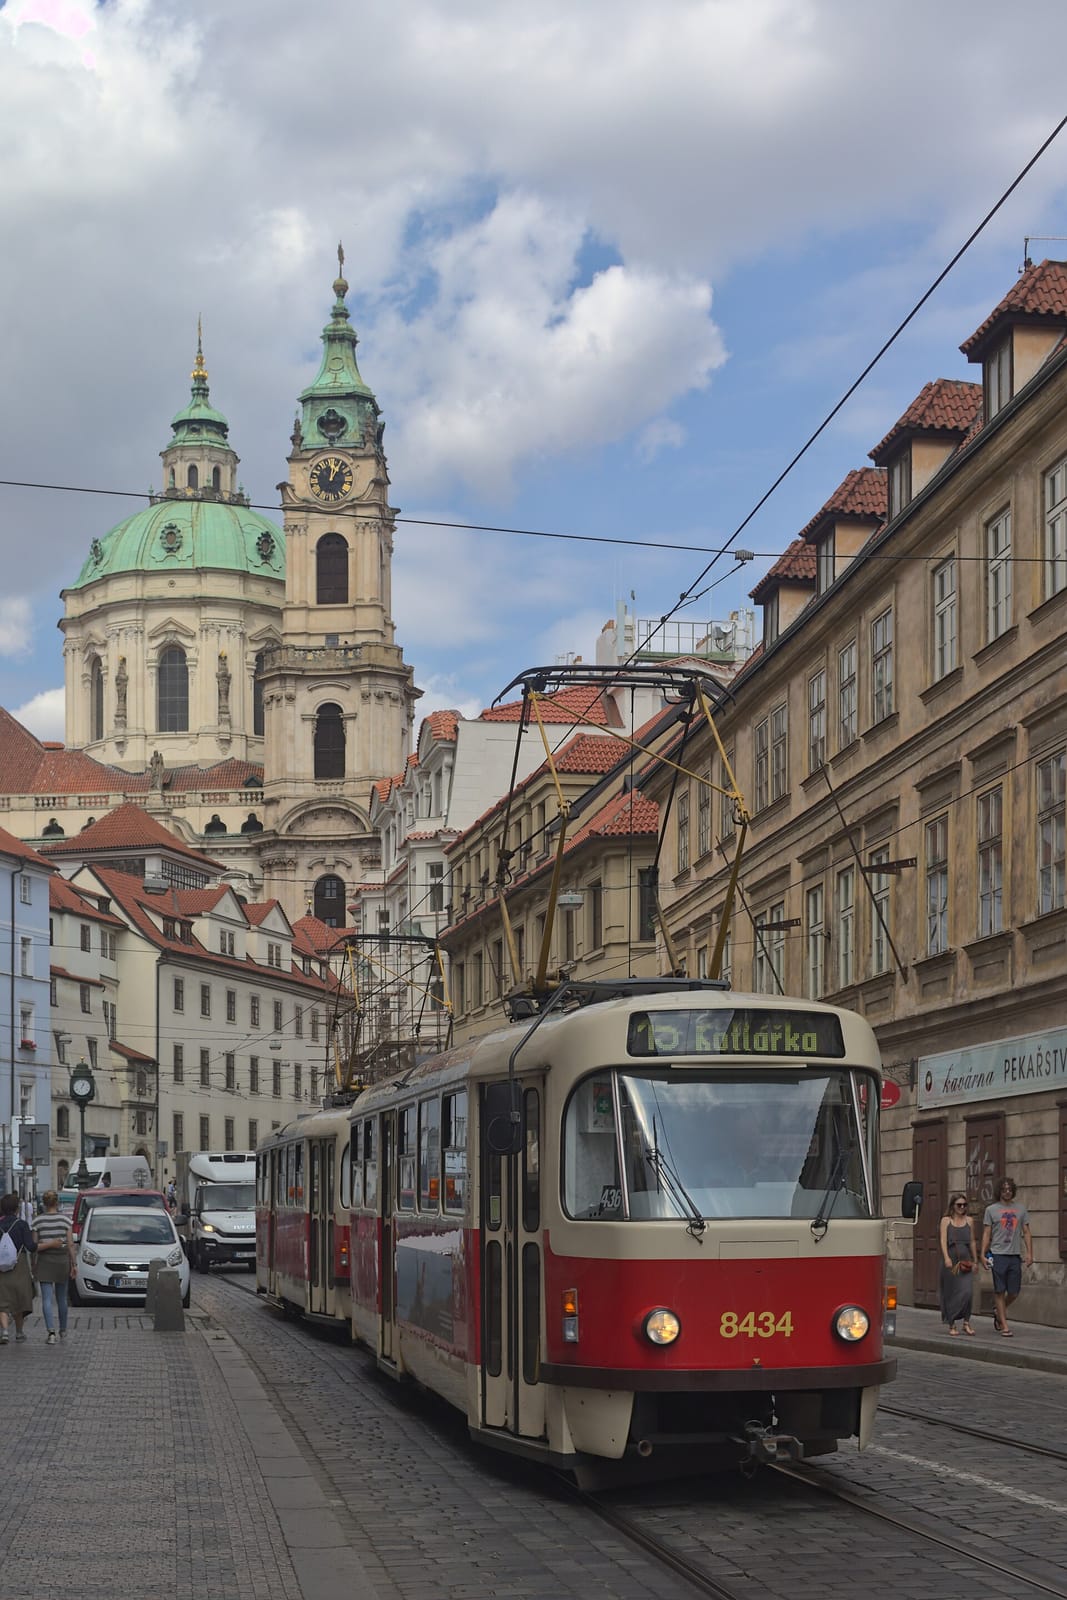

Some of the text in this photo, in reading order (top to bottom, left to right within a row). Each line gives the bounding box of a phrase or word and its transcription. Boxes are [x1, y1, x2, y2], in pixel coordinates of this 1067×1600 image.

[637, 1020, 817, 1052] 15 Kotlářka
[942, 1045, 1067, 1094] kavárna PEKAŘSTV
[719, 1311, 794, 1338] 8434
